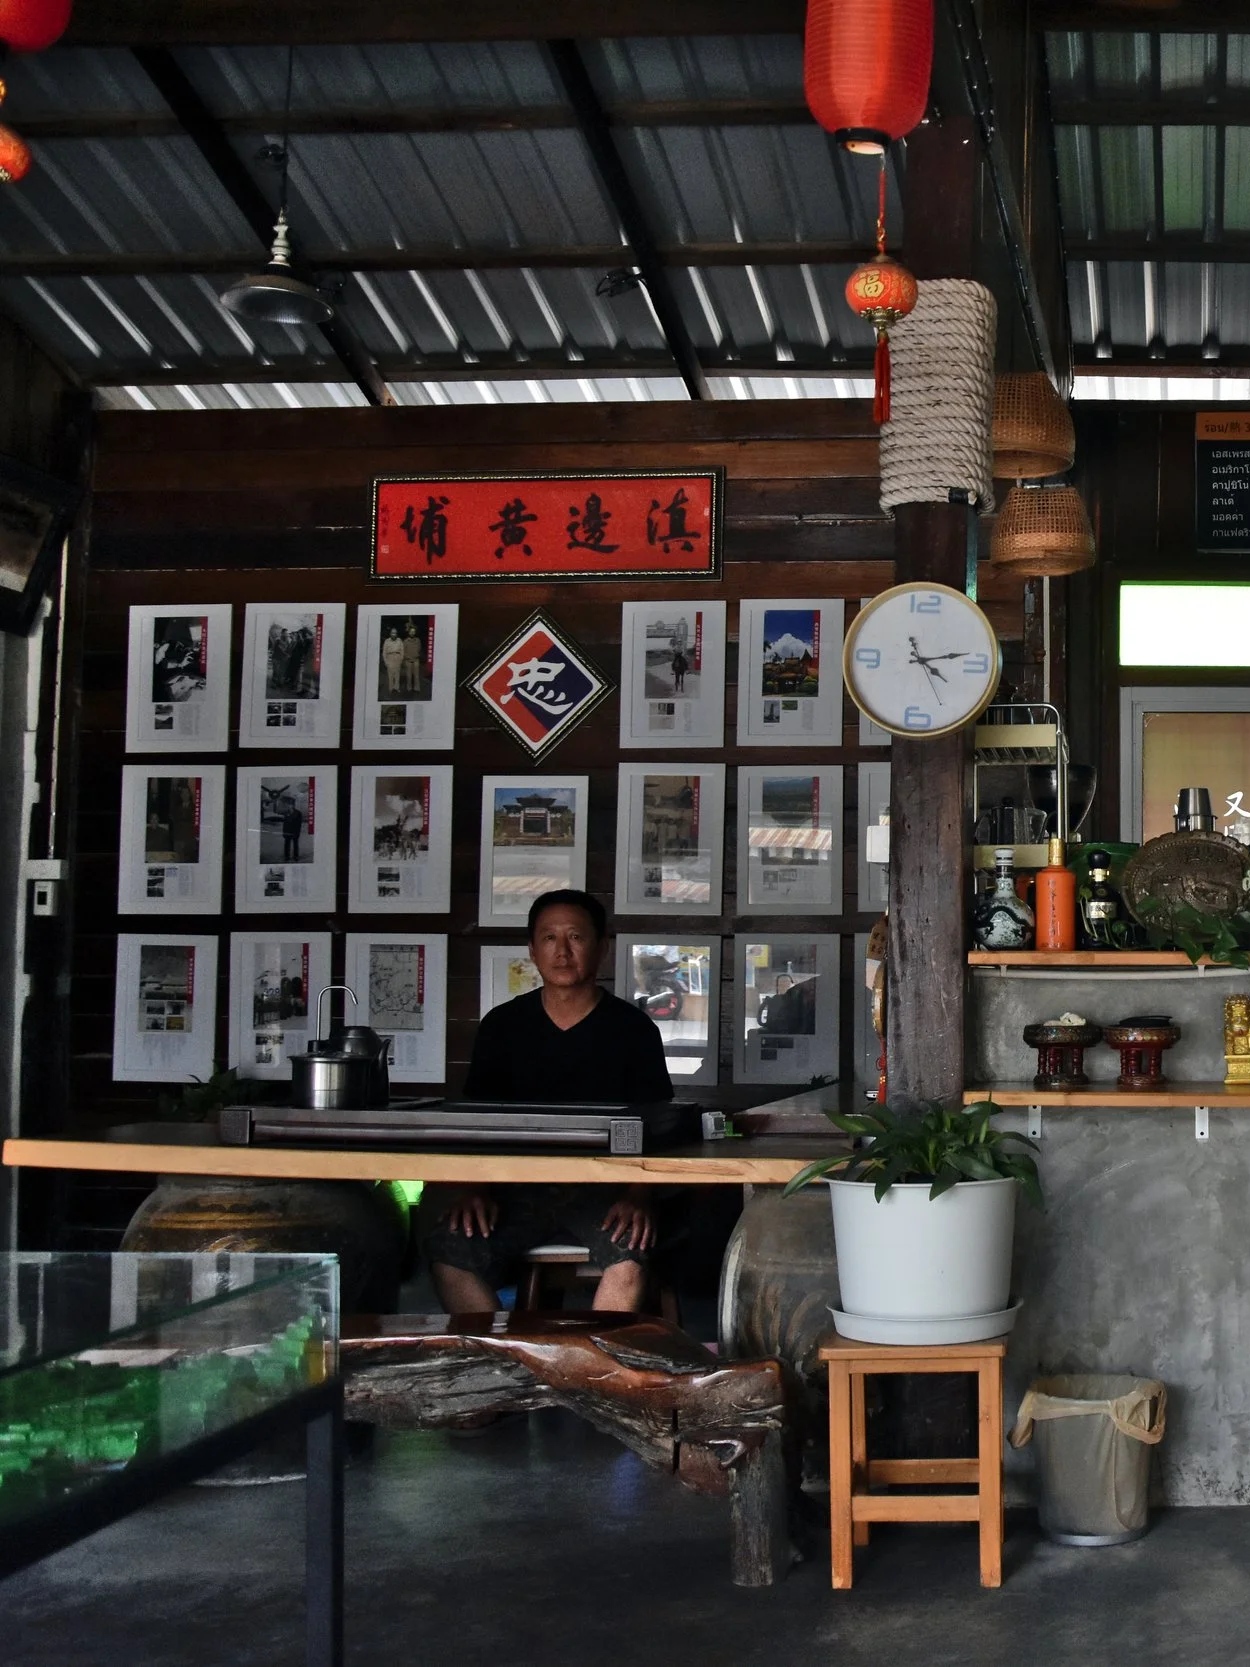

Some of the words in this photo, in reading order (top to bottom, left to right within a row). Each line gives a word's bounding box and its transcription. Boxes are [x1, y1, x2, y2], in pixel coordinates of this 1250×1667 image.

[854, 269, 885, 298] 福
[910, 594, 942, 614] 12
[855, 647, 881, 669] 9
[963, 653, 989, 674] 3
[904, 705, 931, 728] 6
